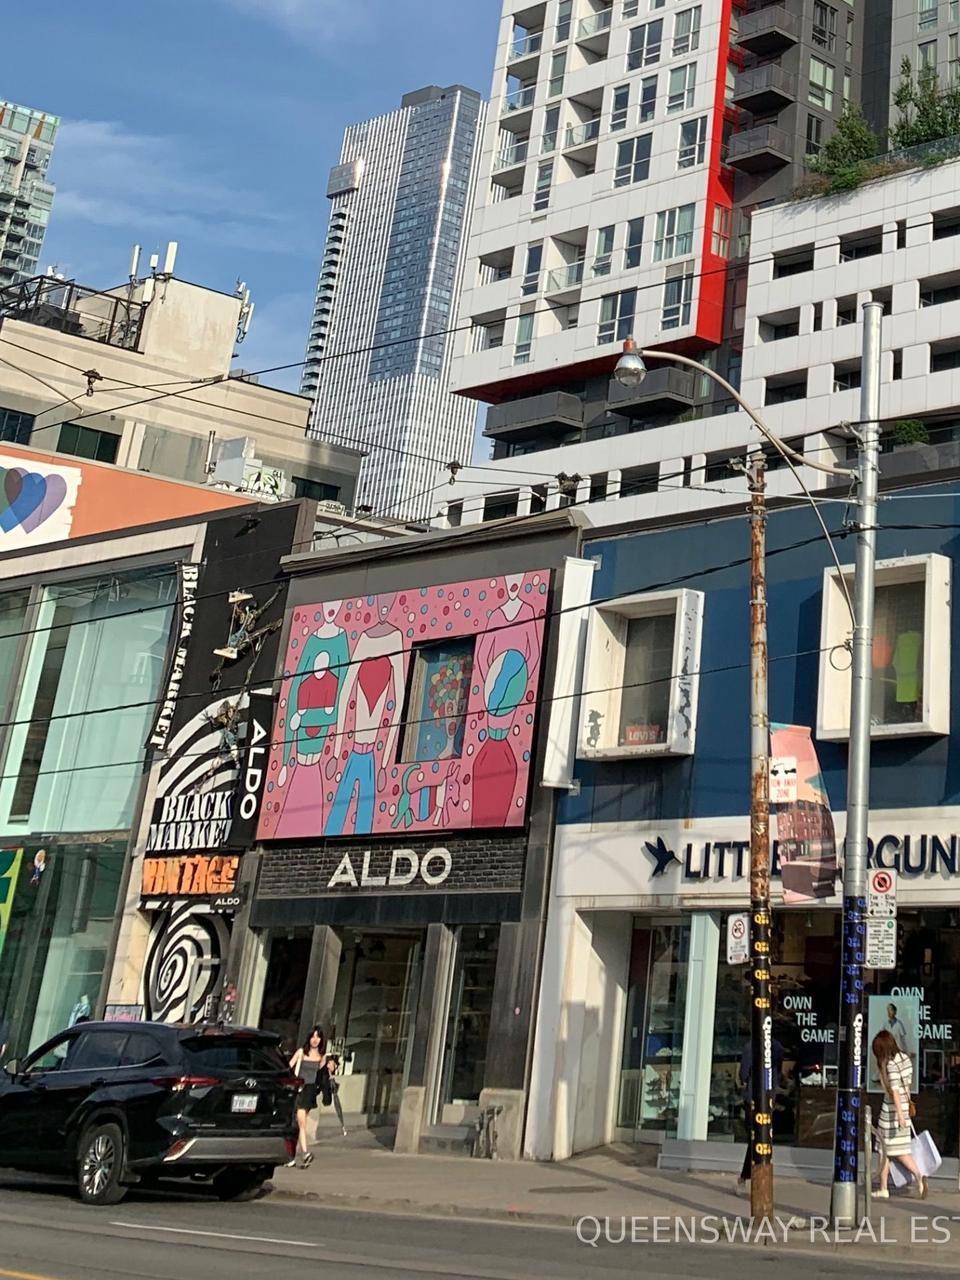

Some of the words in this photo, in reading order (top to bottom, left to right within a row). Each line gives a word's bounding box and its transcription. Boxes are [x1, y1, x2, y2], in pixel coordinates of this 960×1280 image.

[179, 565, 199, 638] BLACK
[150, 647, 188, 750] MARKET
[240, 719, 267, 819] ALDO
[160, 790, 234, 823] BLACK
[327, 847, 453, 888] ALDO
[215, 896, 240, 906] ALDO
[783, 996, 812, 1010] OWN
[891, 986, 925, 1001] OWN
[796, 1013, 817, 1026] THE
[801, 1029, 835, 1043] GAME
[853, 1013, 863, 1065] Queen
[913, 1024, 952, 1040] GAME
